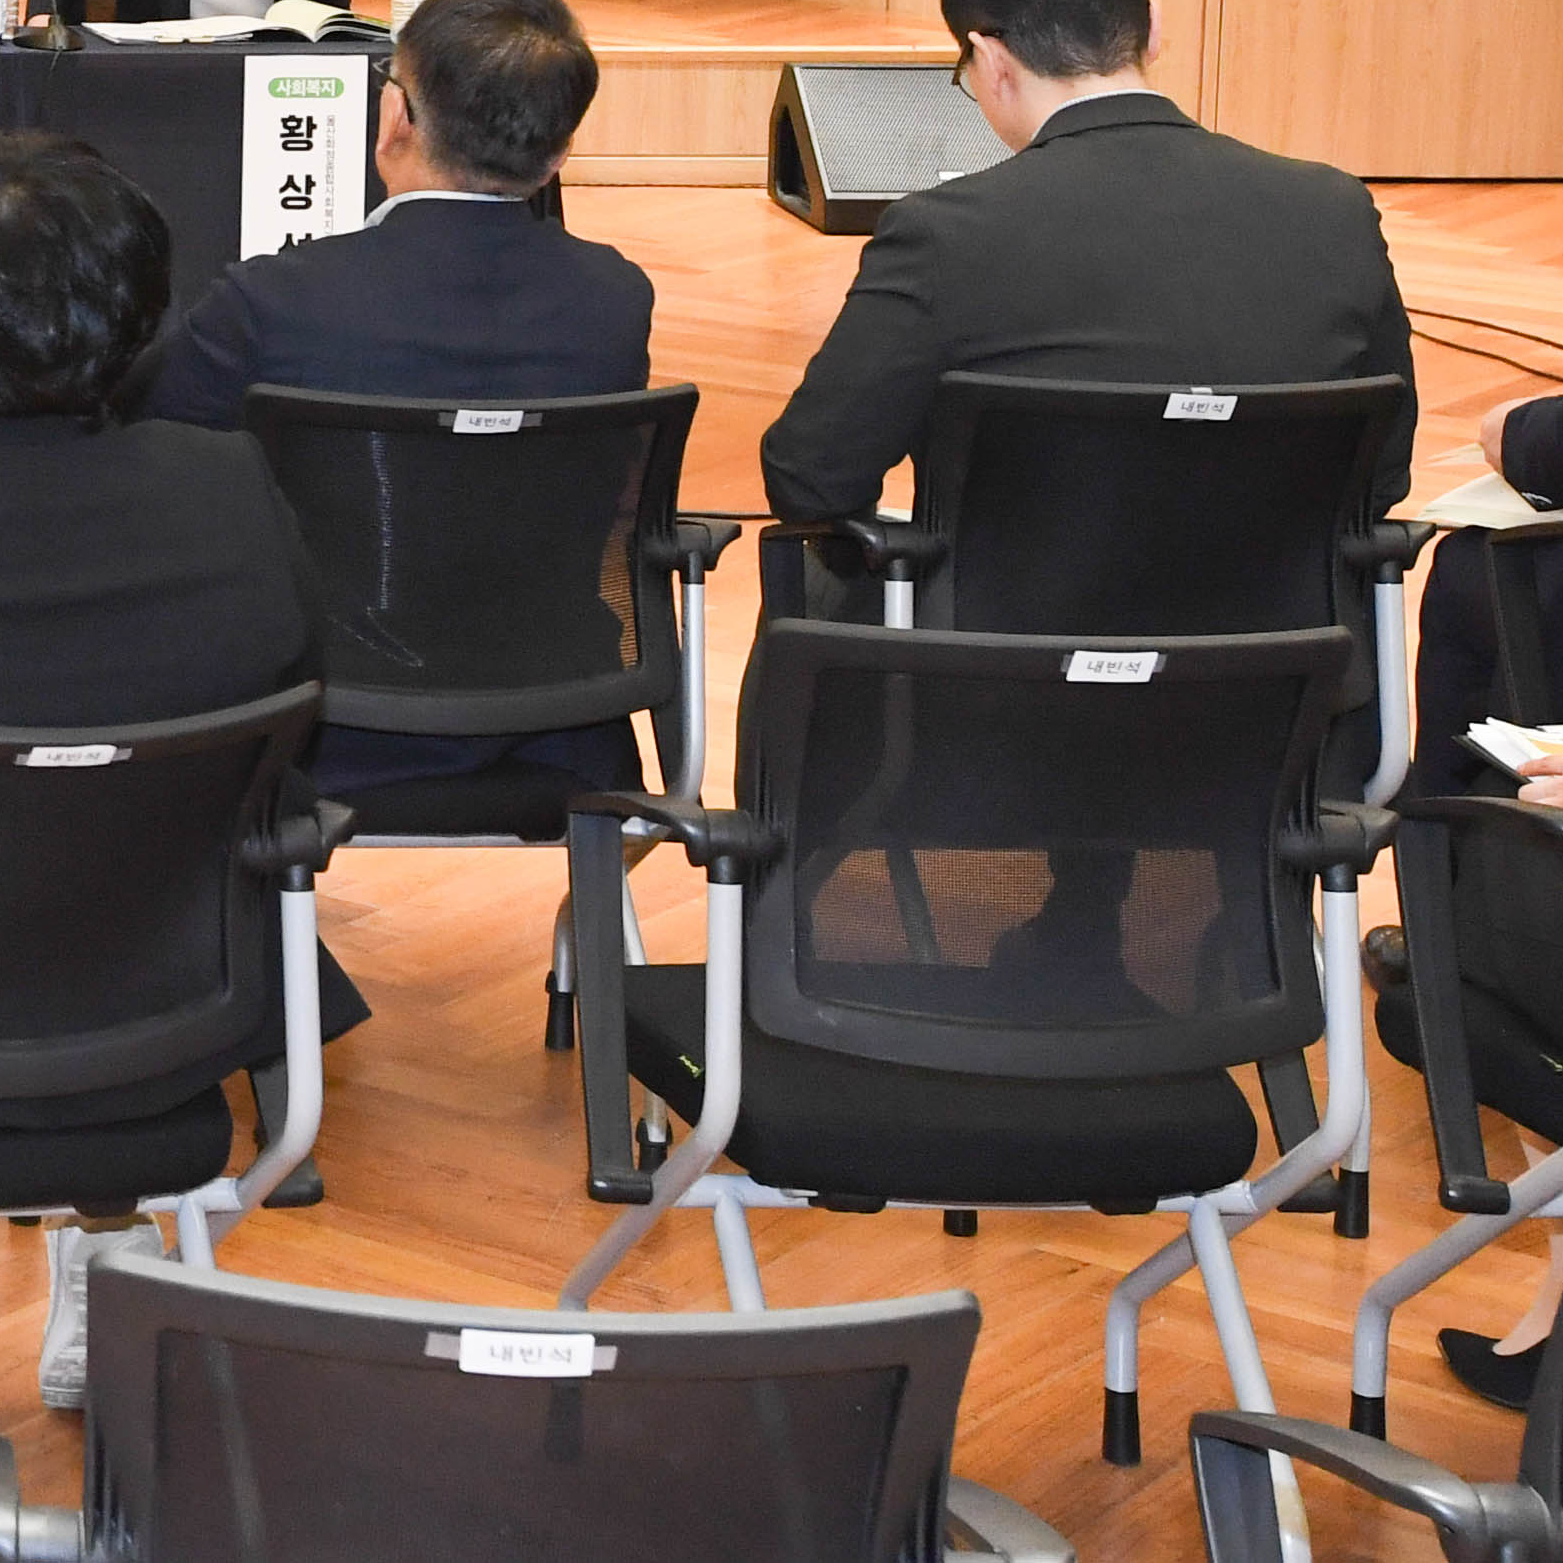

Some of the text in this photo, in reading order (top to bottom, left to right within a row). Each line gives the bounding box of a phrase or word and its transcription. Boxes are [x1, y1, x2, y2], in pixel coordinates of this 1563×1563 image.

[277, 79, 336, 97] 사회복지
[1181, 401, 1224, 413] 내빈석
[468, 415, 512, 428] 내빈석
[1086, 660, 1142, 674] 내빈석
